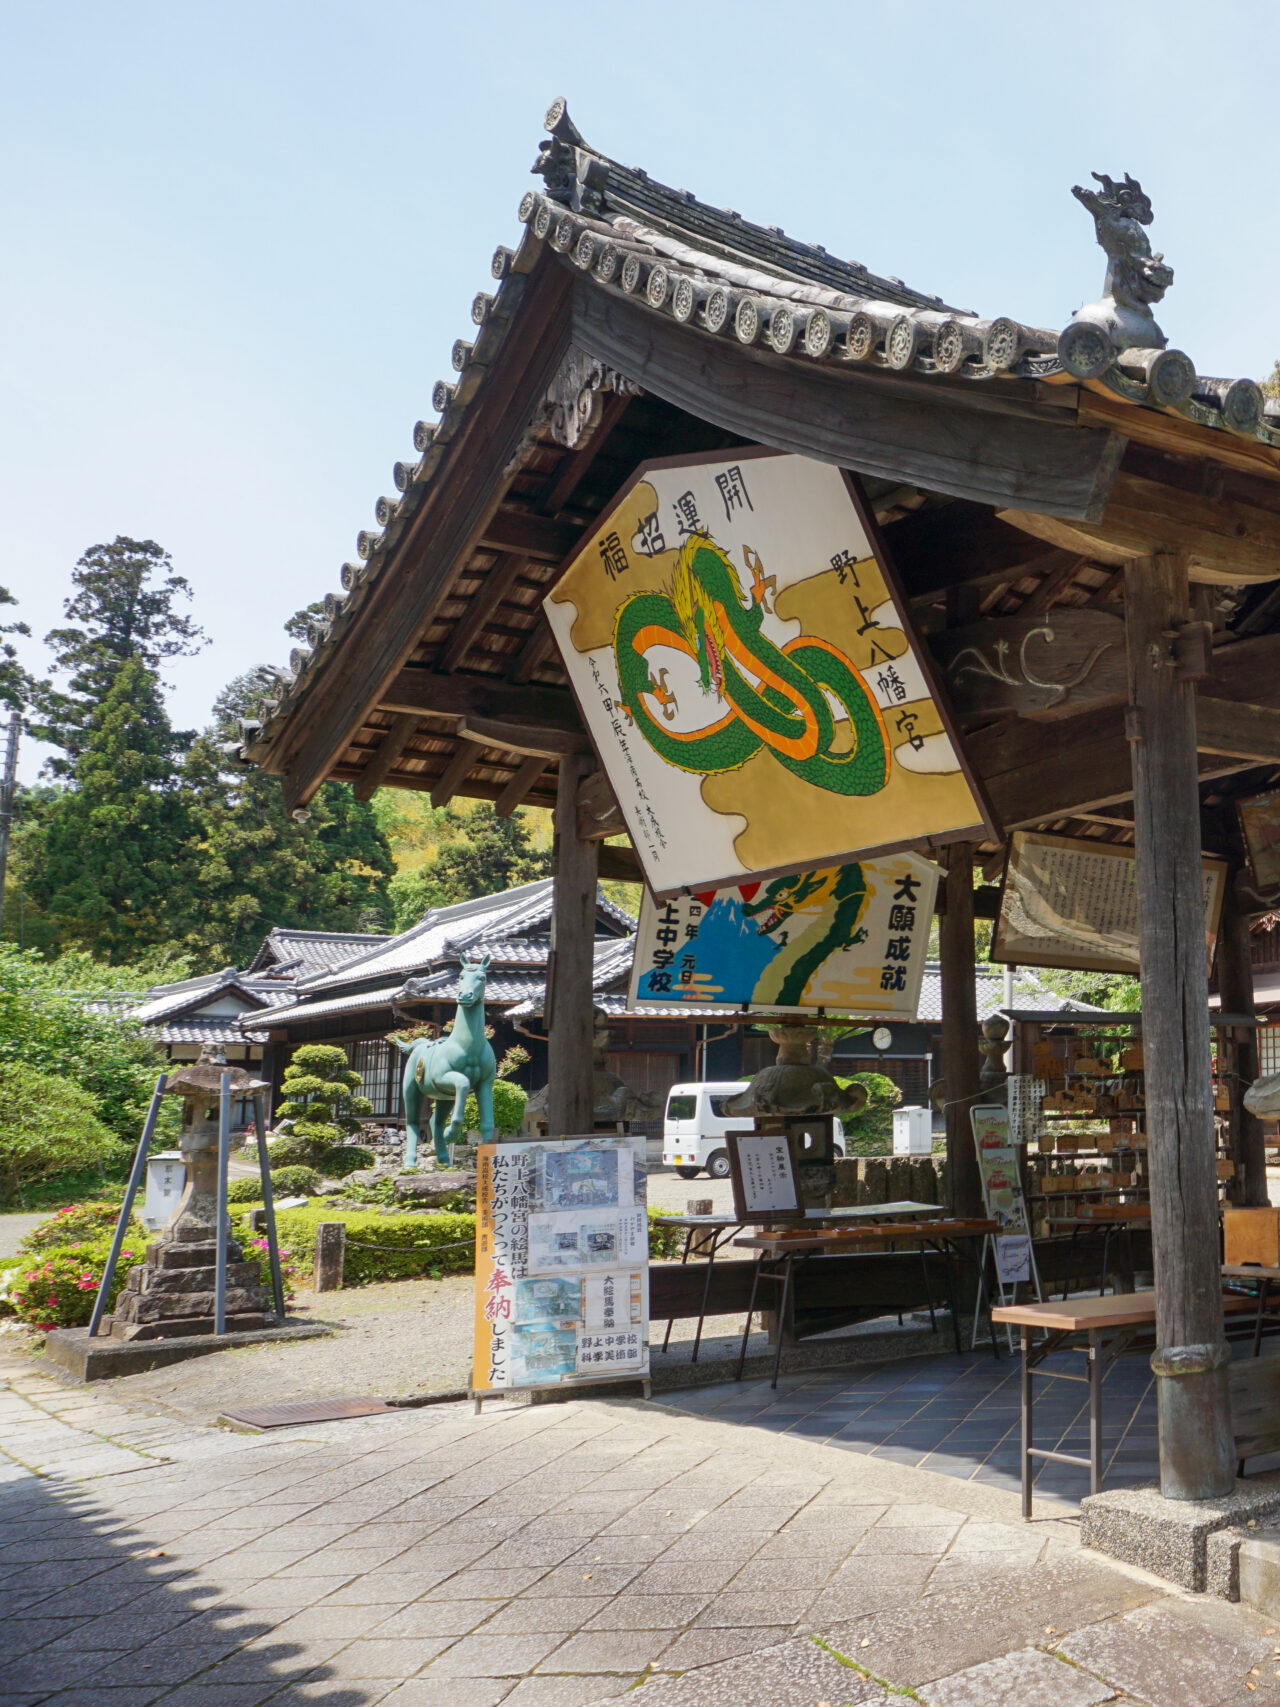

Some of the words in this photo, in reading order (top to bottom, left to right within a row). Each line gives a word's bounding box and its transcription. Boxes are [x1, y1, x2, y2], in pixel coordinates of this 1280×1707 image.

[829, 548, 925, 752] 野上八幡宮
[647, 897, 680, 993] 上中学校
[680, 953, 697, 985] 元旦
[879, 873, 922, 992] 大願成就
[485, 1154, 513, 1382] 私たちがつくって奉納しました
[510, 1153, 530, 1280] 野上八幡宮の絵馬は
[581, 1334, 638, 1349] 野上中学校
